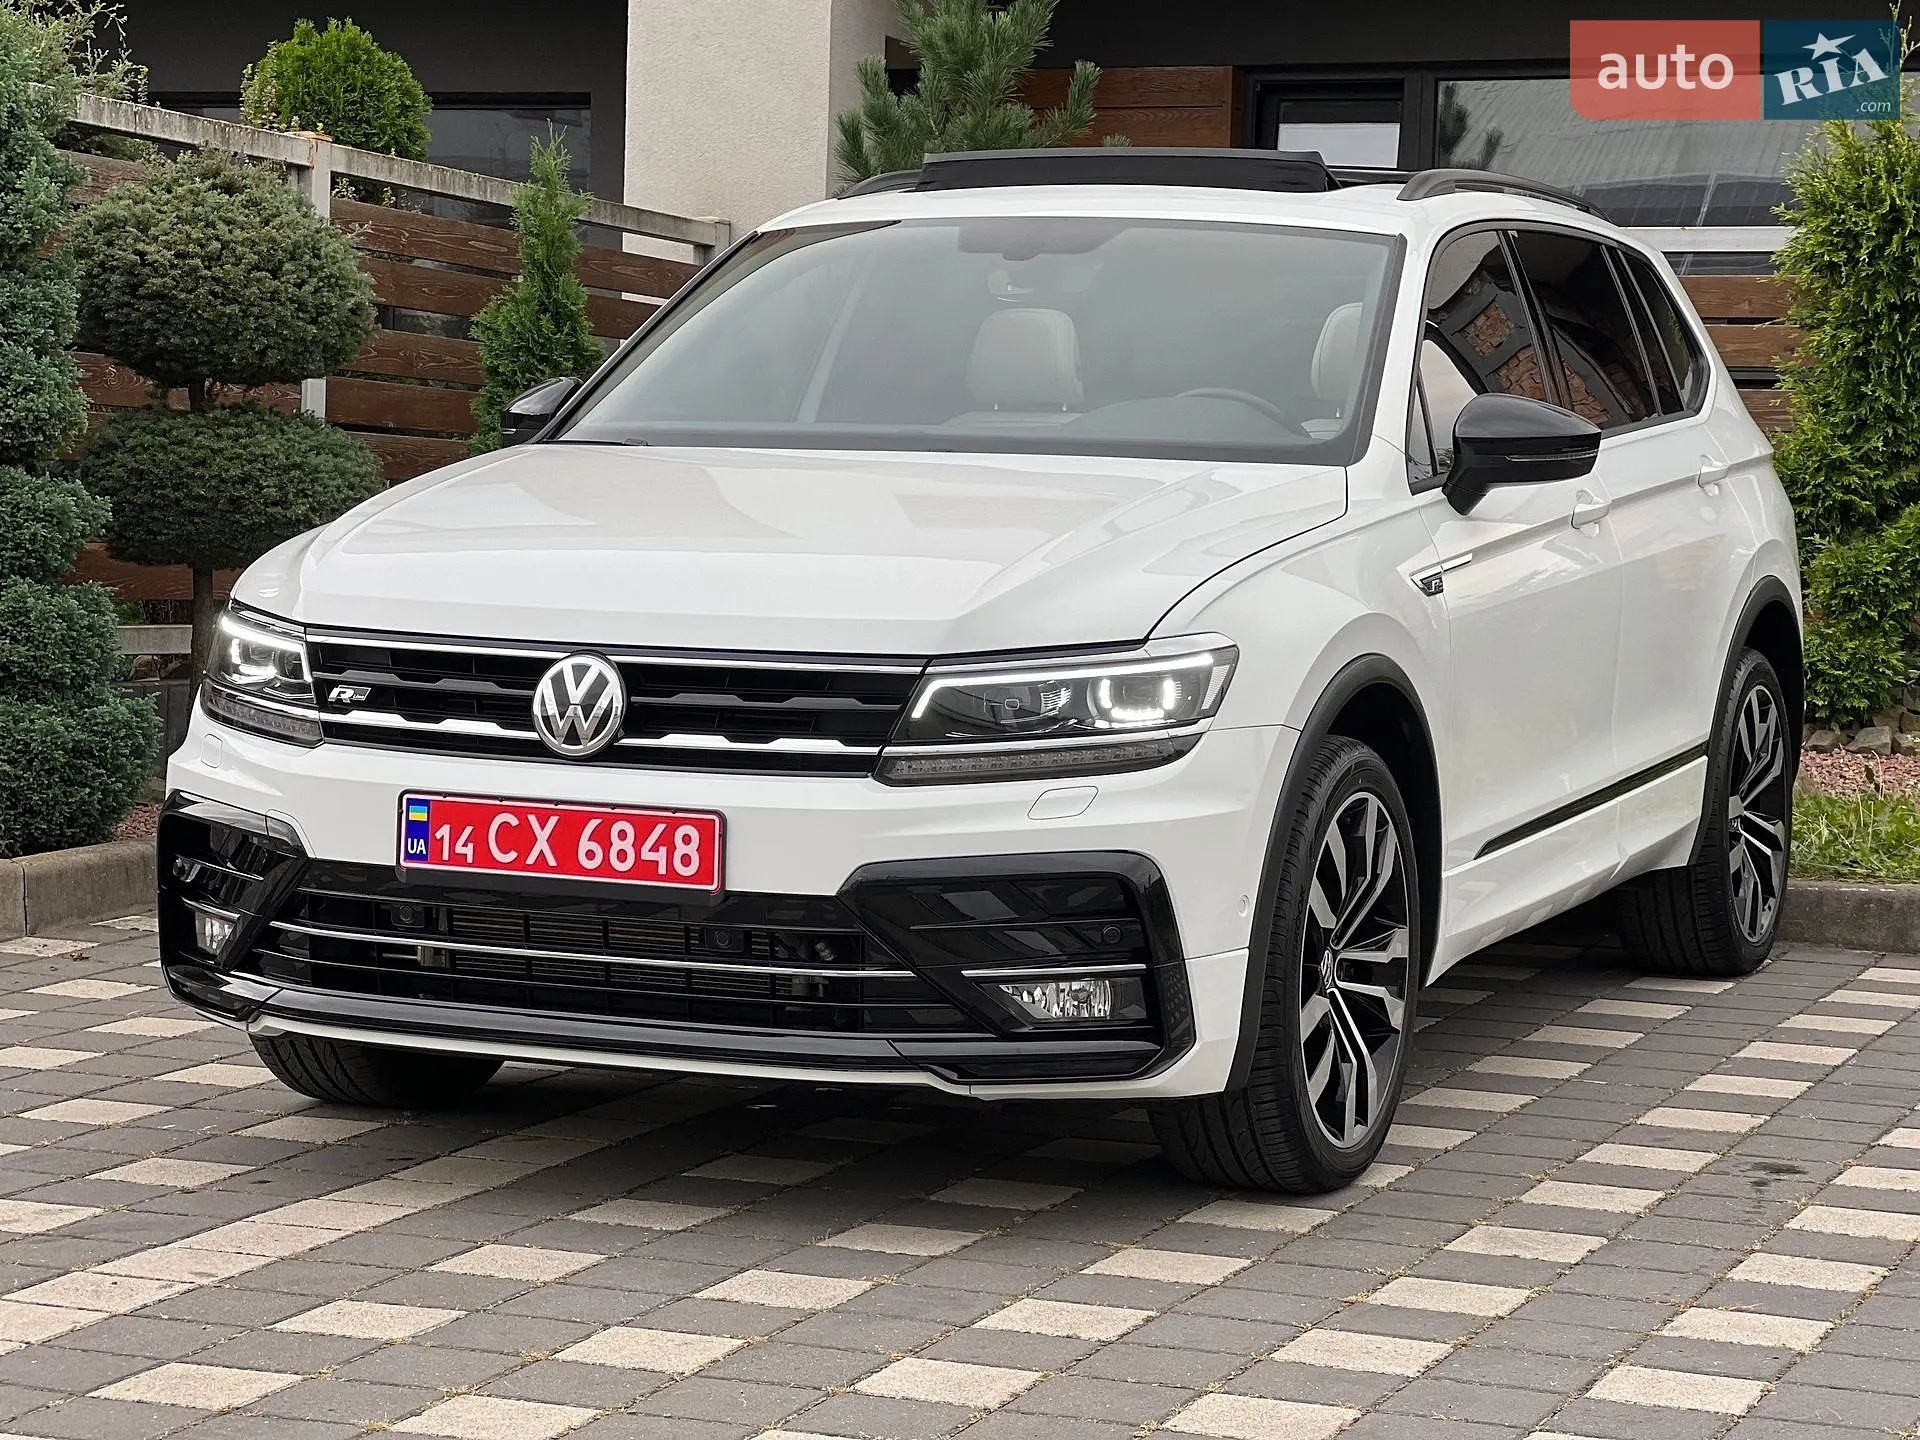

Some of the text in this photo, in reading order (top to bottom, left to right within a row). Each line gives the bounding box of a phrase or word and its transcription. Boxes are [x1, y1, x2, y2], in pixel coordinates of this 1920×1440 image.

[328, 687, 355, 703] R
[407, 837, 427, 855] UA
[434, 812, 701, 877] 14 CX 6848
